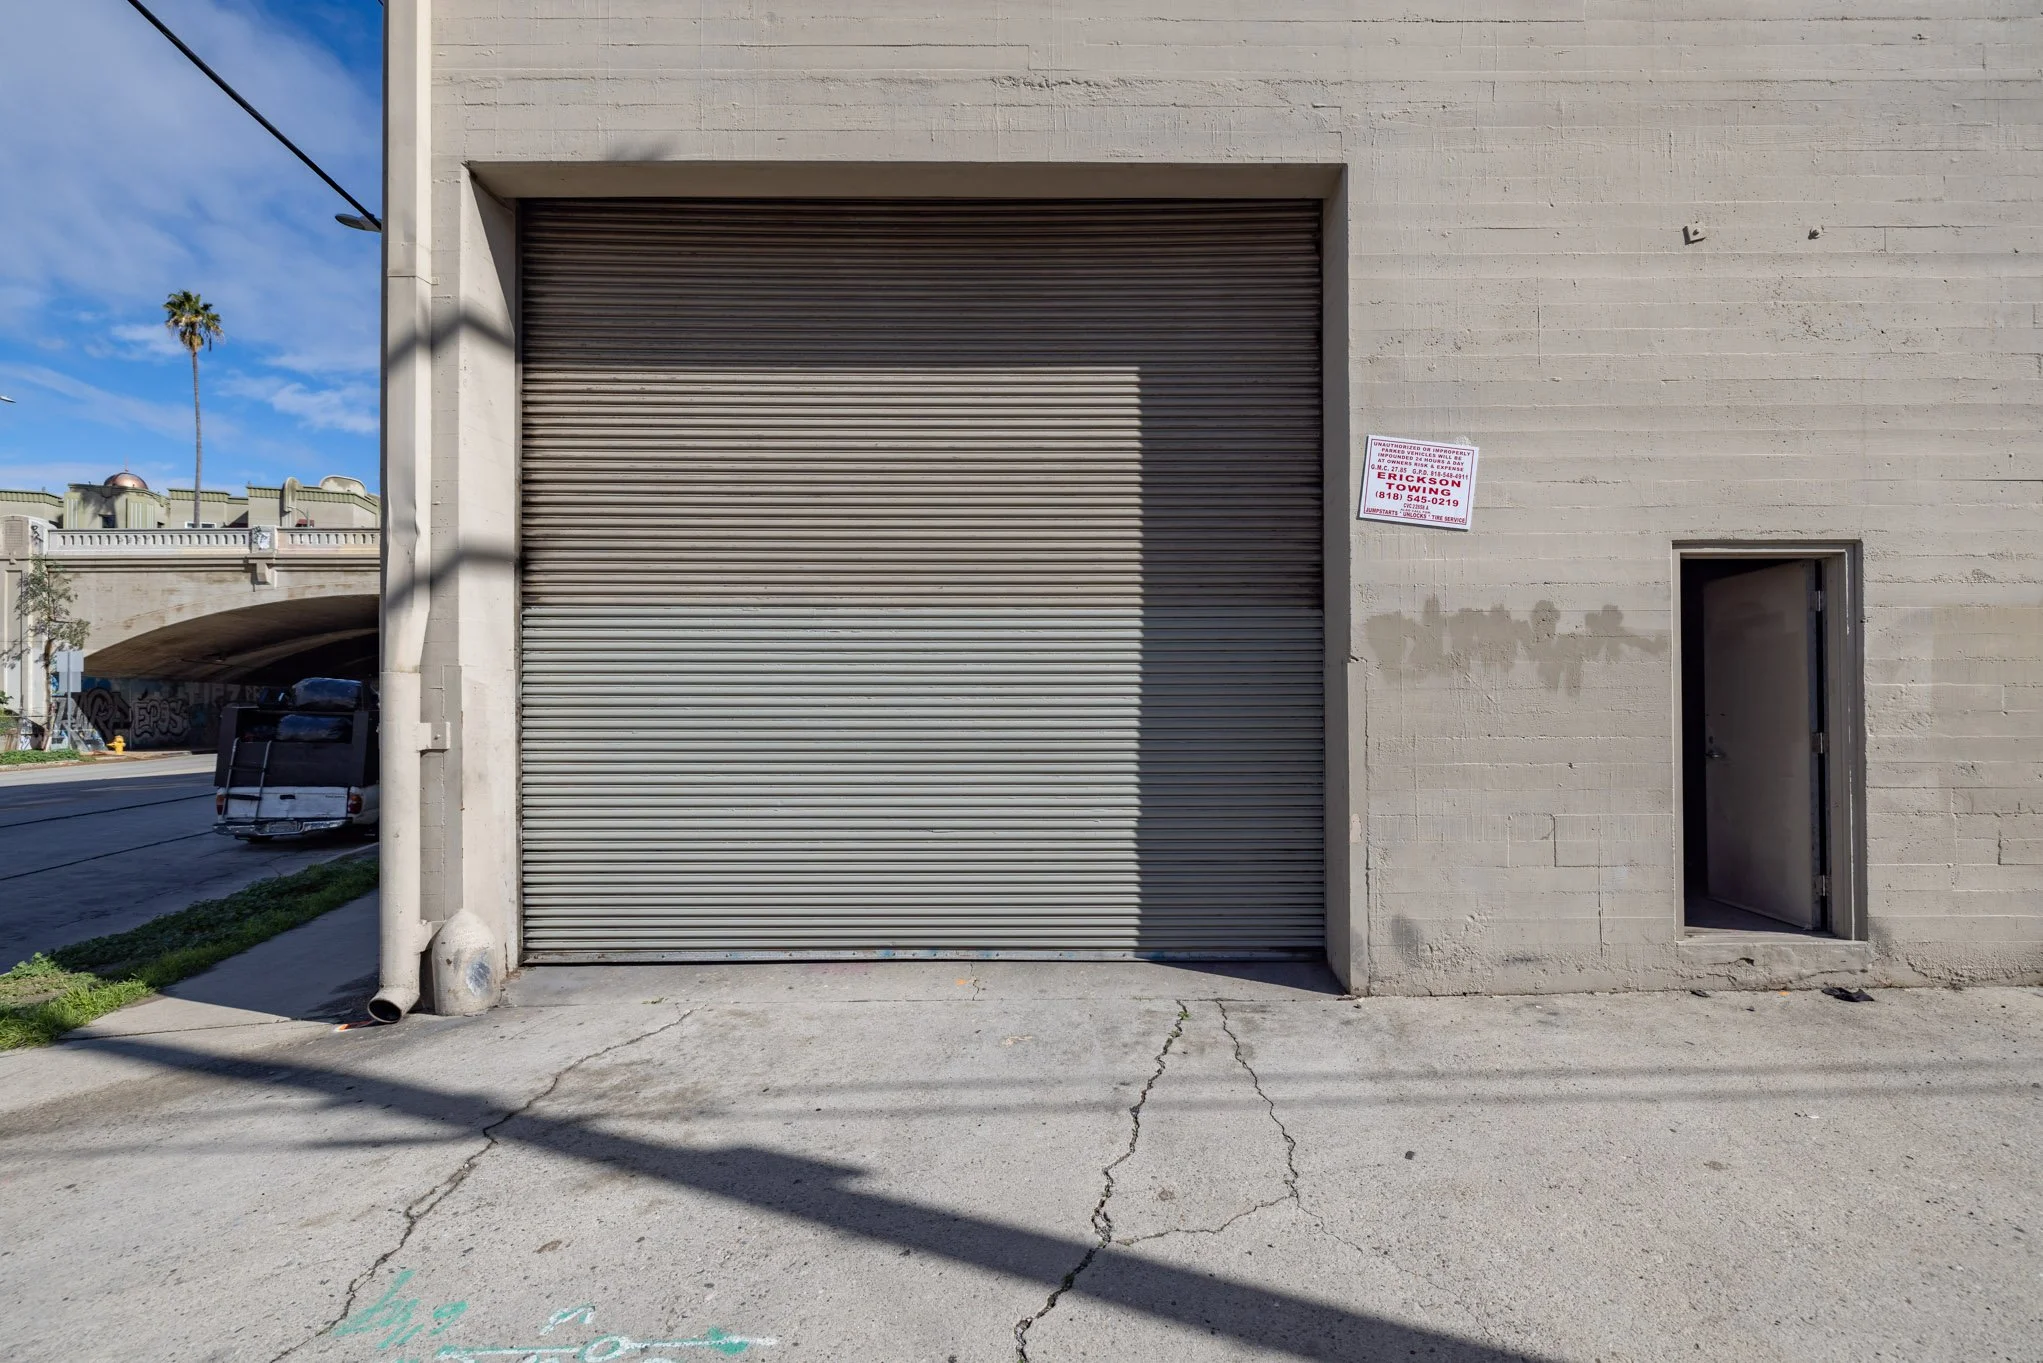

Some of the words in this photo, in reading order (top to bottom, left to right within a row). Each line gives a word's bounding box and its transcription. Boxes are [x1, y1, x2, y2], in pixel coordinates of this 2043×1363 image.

[1374, 442, 1420, 450] UNAUTHORIZED
[1433, 448, 1470, 456] IMPROPERLY
[1377, 472, 1461, 488] ERICKSON
[1430, 470, 1468, 480] 818-548-4911
[1386, 482, 1451, 496] TOWING
[1376, 491, 1402, 500] (818)
[1407, 494, 1459, 507] 545-0219
